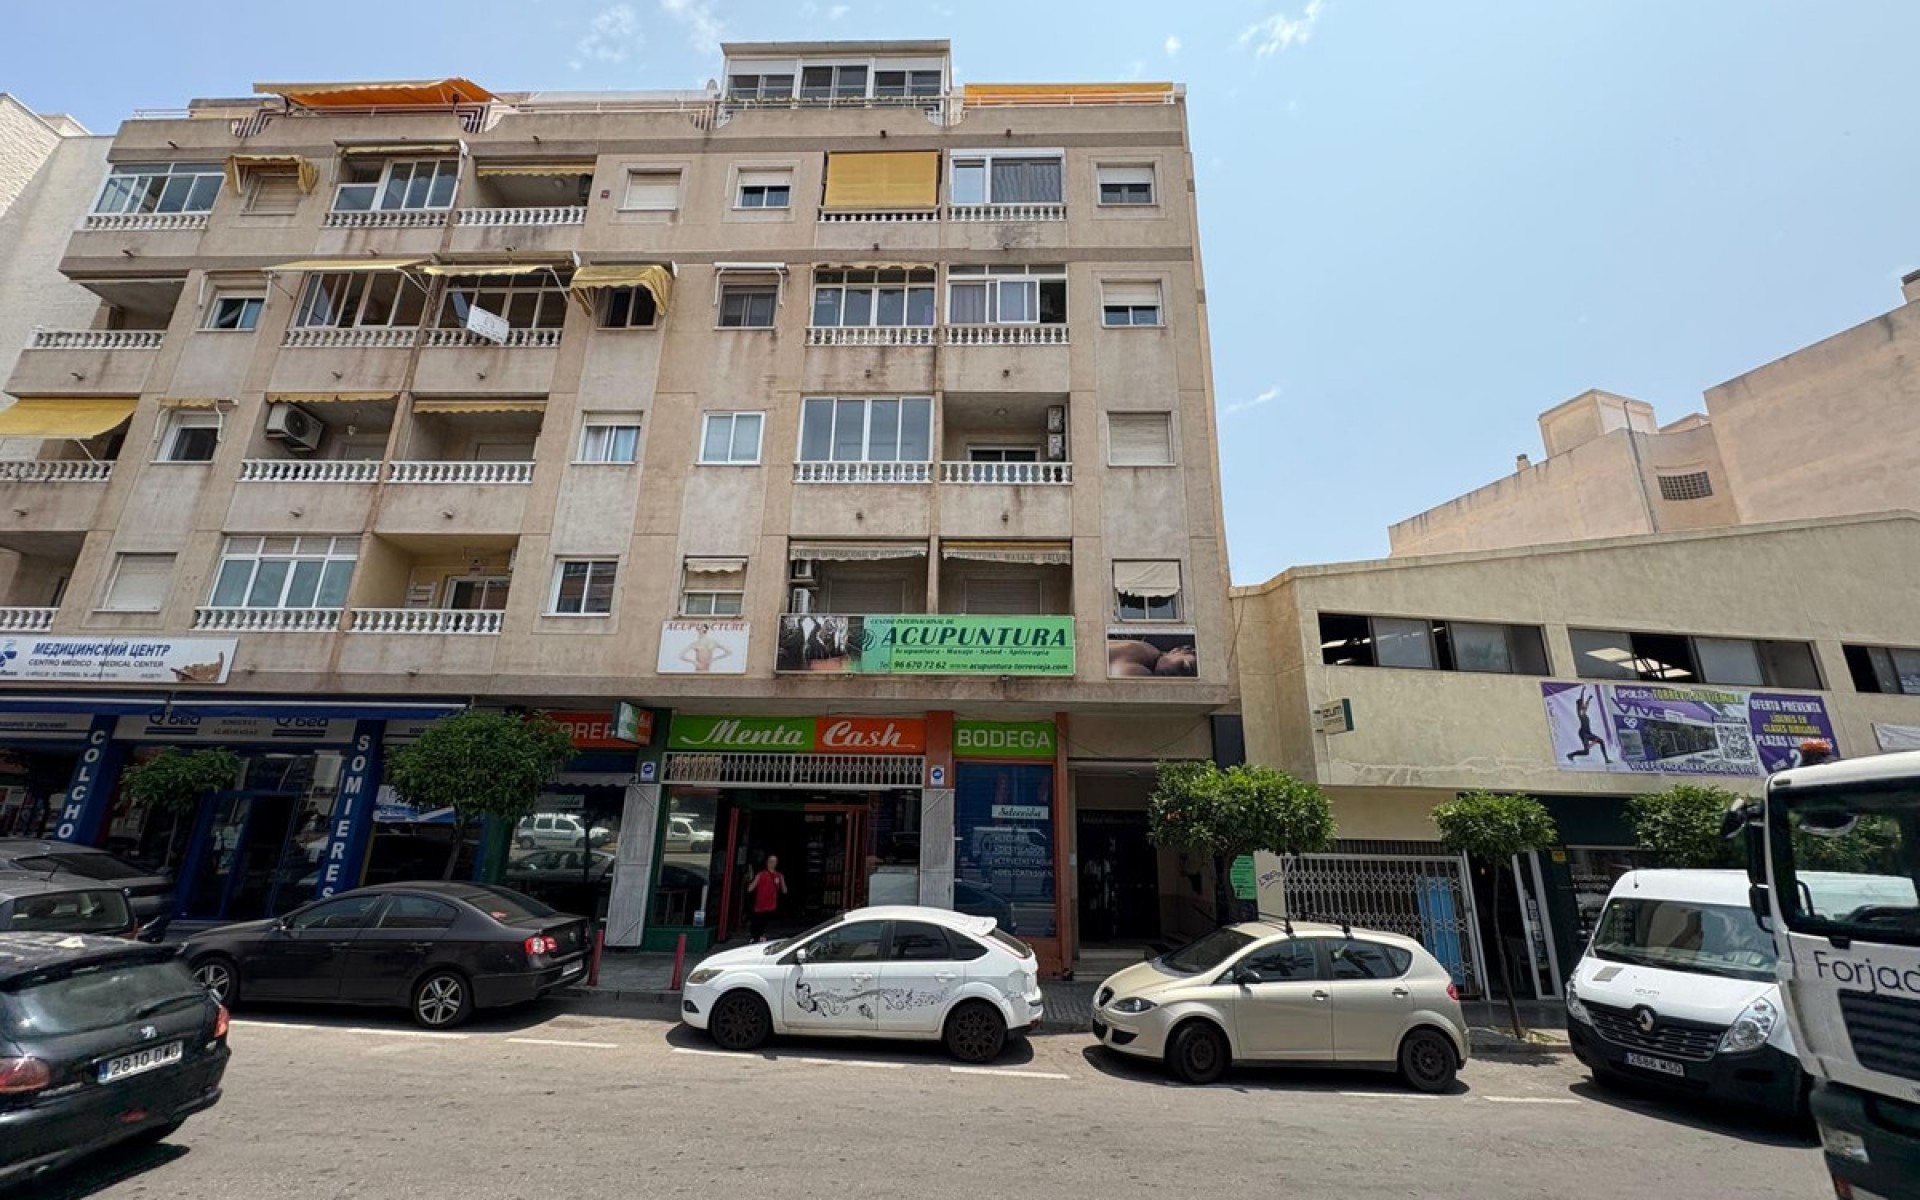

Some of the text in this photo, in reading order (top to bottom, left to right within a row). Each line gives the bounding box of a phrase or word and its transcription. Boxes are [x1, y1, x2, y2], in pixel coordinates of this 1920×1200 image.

[881, 626, 1066, 646] ACUPUNTURA
[32, 641, 171, 658] МЕДИЦИНСКИЙ ЦЕНТР
[28, 659, 60, 667] CENTRO
[906, 661, 923, 669] 670
[1751, 699, 1780, 710] OFERTA
[680, 719, 916, 748] Menta Cash
[957, 729, 1050, 747] BODEGA
[58, 730, 105, 838] COLCHO
[322, 735, 371, 898] SOMIERES
[111, 1051, 151, 1076] 2810
